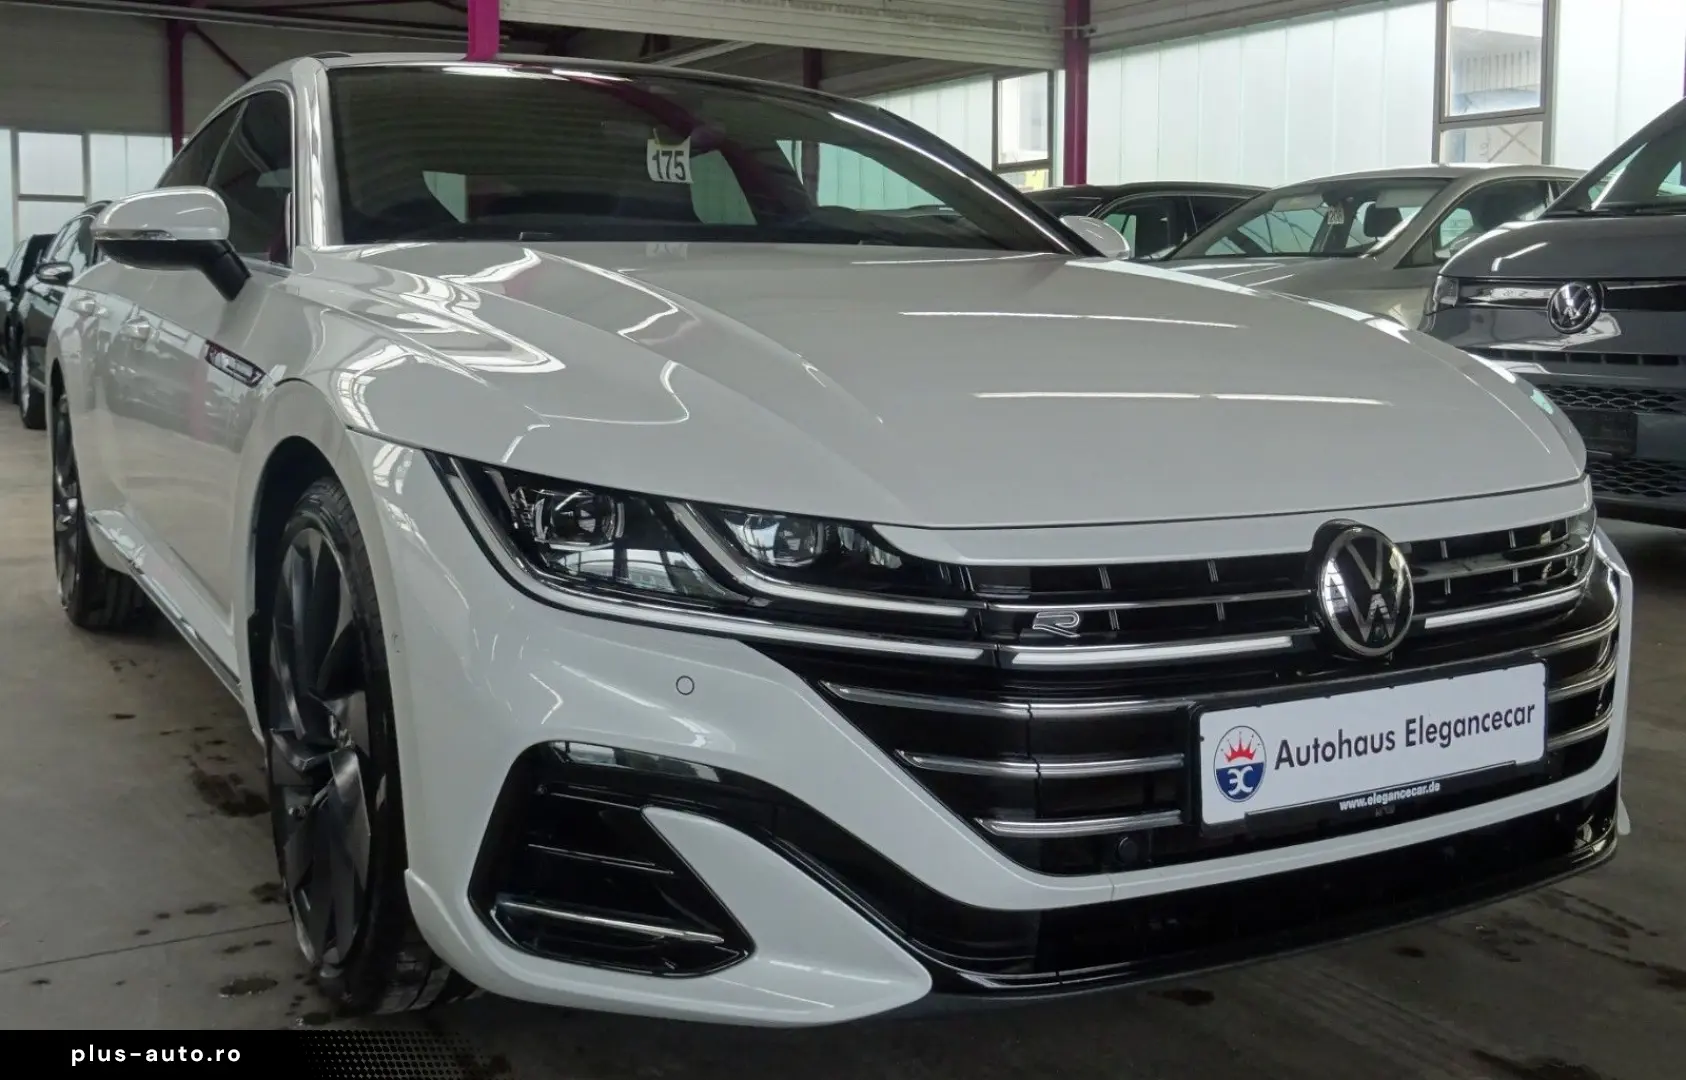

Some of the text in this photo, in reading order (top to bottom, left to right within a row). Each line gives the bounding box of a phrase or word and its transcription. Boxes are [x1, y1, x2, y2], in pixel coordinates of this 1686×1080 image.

[652, 150, 687, 181] 175
[1274, 703, 1536, 771] Autohaus Elegancecar
[1338, 781, 1441, 812] www.elegancecar.de
